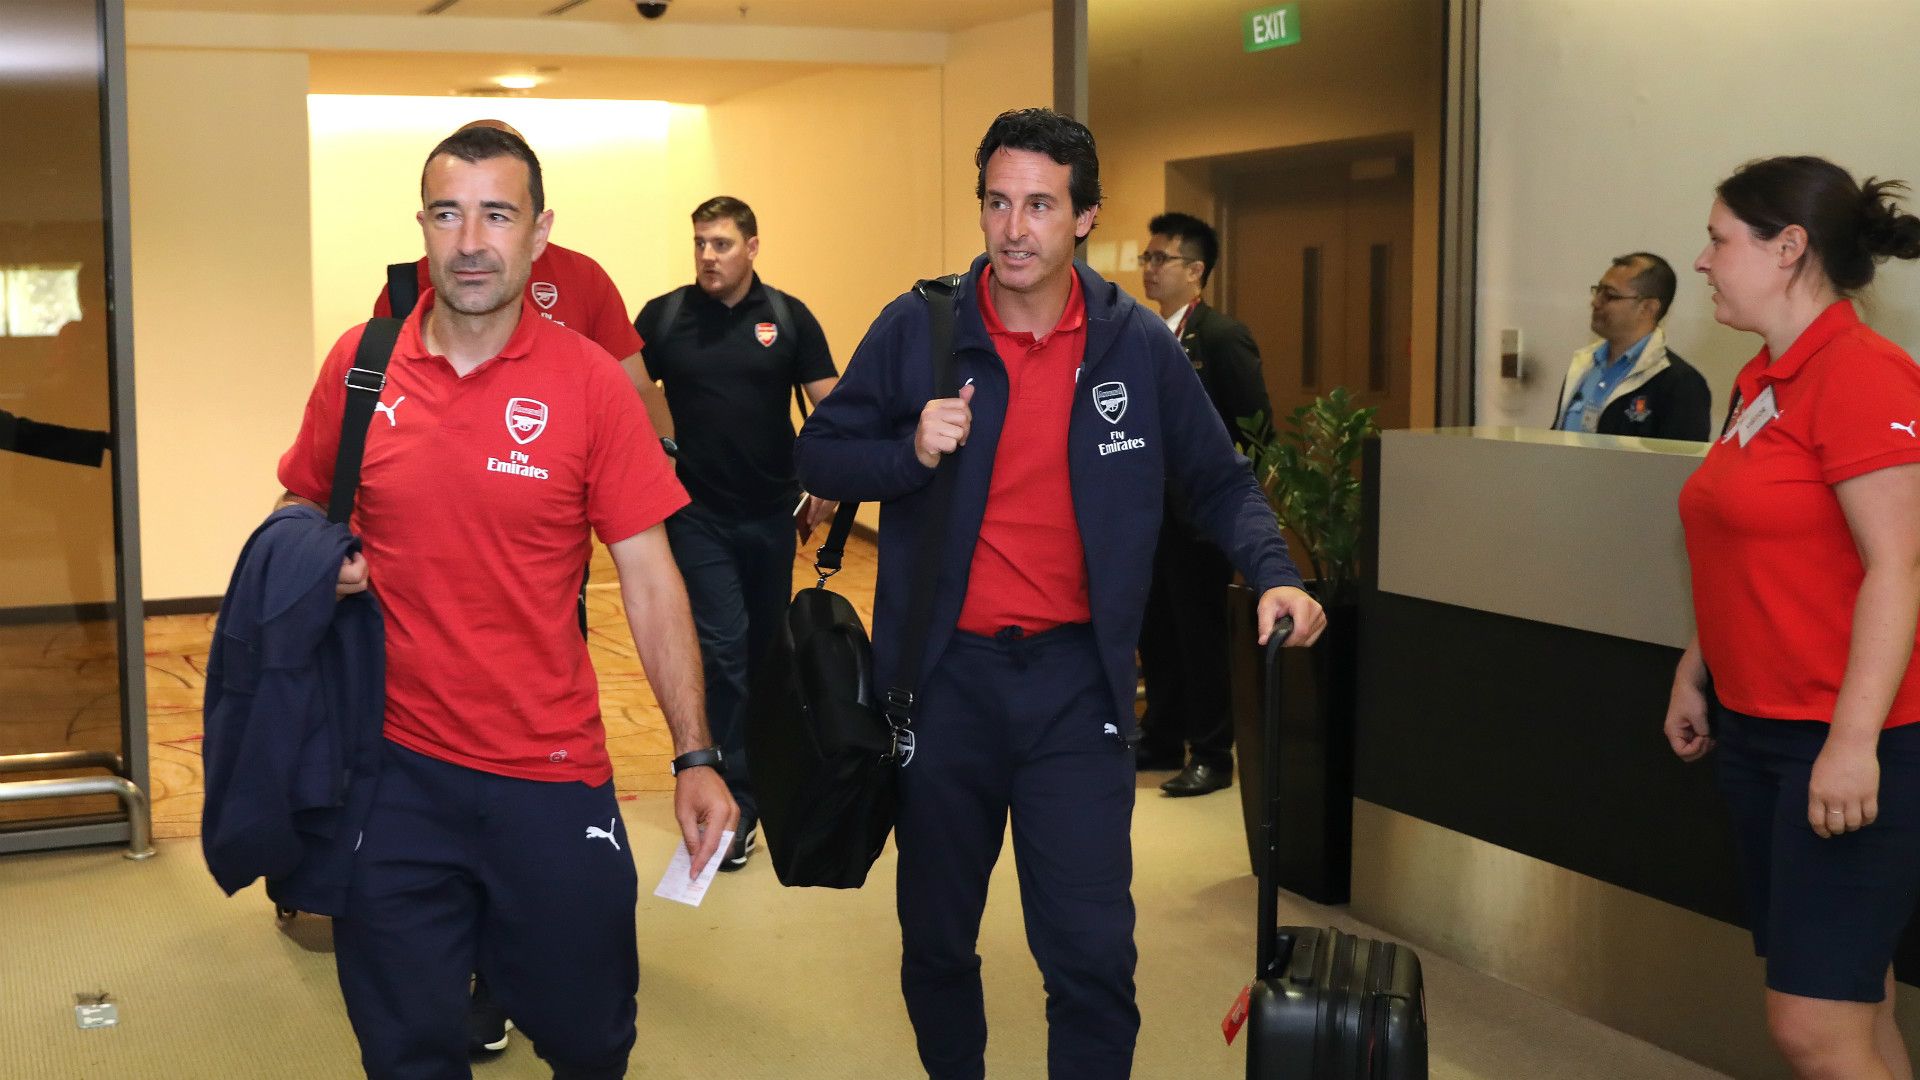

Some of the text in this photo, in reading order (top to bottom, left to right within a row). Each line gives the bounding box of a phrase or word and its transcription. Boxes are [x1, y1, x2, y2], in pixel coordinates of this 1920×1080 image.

[1253, 9, 1286, 44] EXIT
[1110, 431, 1125, 440] Fly
[1098, 438, 1145, 456] Emirates
[510, 450, 529, 464] Fly
[487, 457, 549, 480] Emirates
